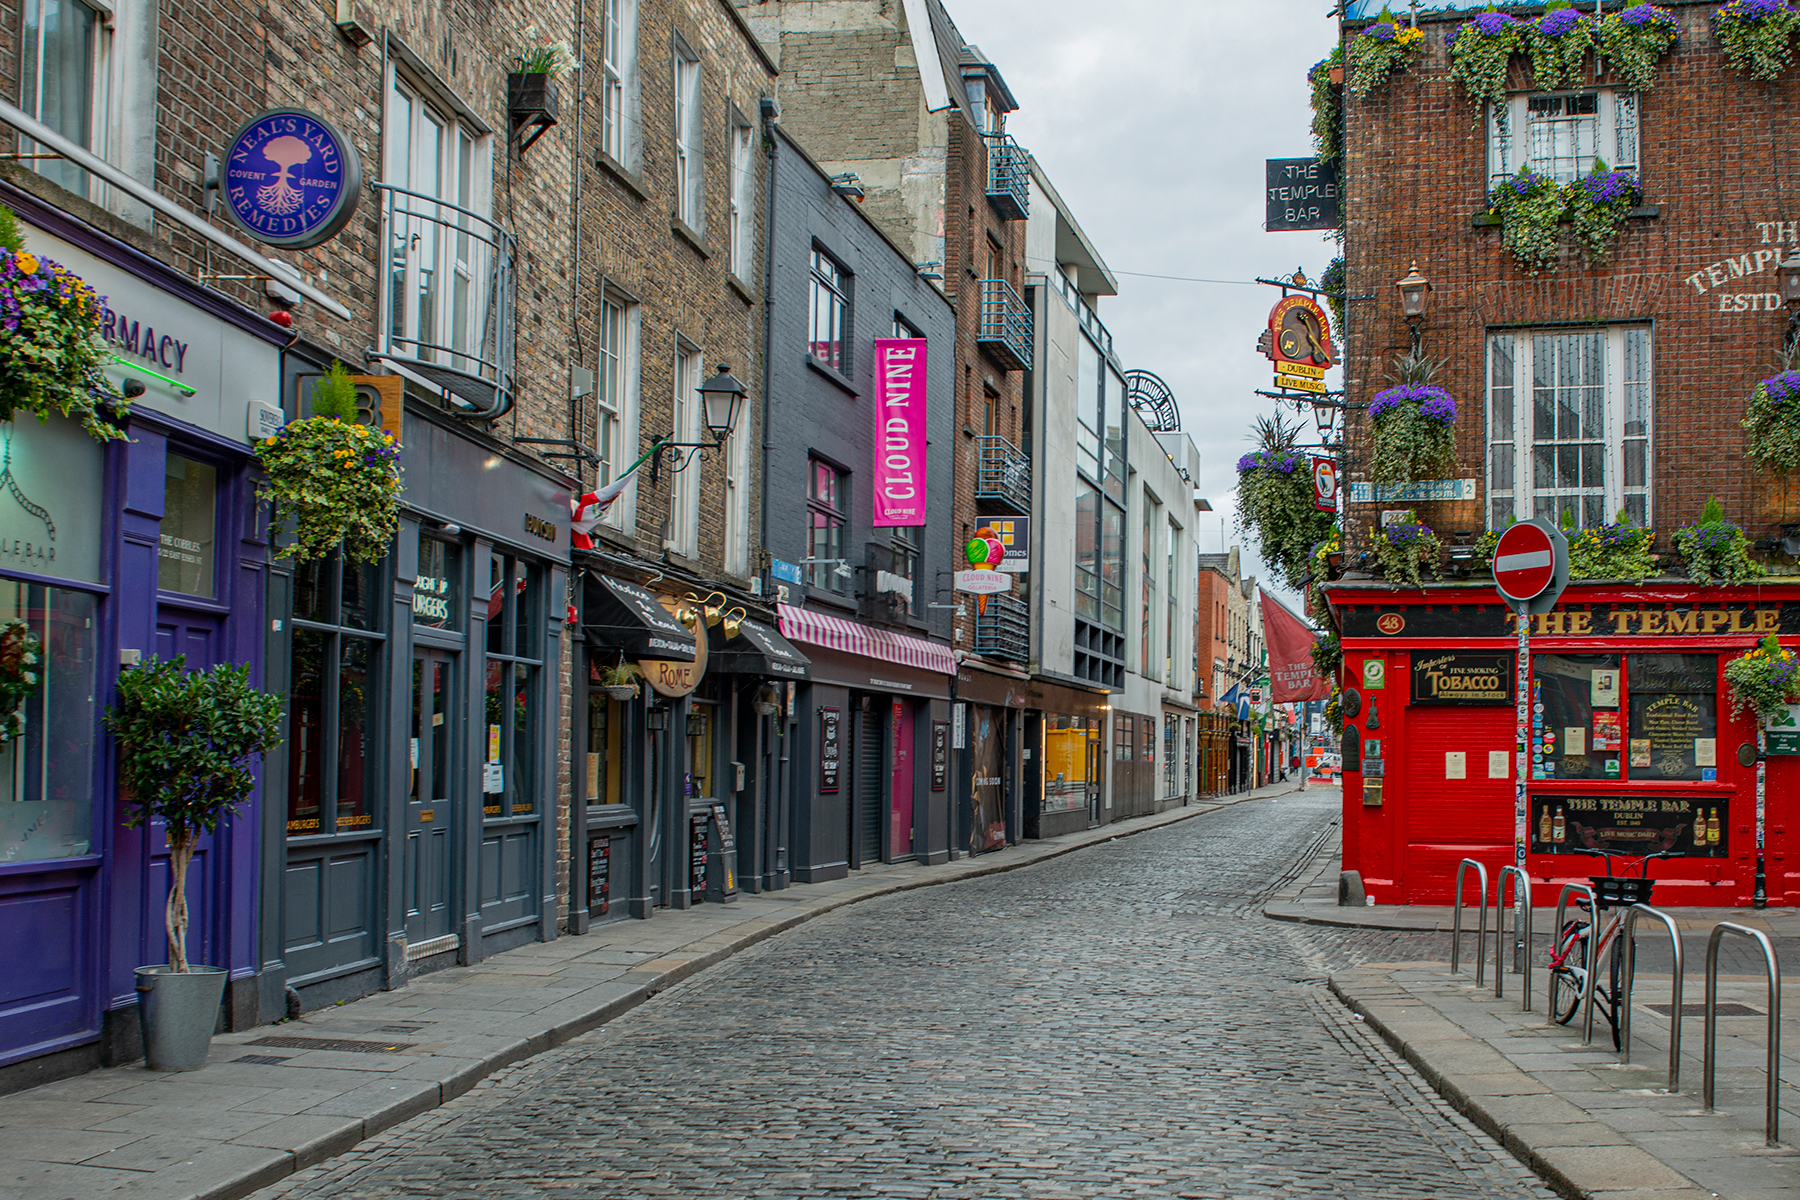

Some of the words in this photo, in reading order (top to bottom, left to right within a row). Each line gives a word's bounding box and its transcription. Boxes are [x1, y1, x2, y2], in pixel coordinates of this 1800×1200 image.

[232, 119, 297, 164] NEAL'S
[302, 122, 338, 174] YARD
[229, 169, 266, 181] COVENT
[299, 177, 337, 190] GARDEN
[1285, 165, 1318, 179] THE
[1268, 183, 1335, 201] TEMPLE
[230, 186, 330, 232] REMEDIES
[1285, 206, 1320, 222] BAR
[1683, 247, 1783, 295] TEMPL
[1274, 308, 1286, 332] THE
[1283, 298, 1320, 316] TEMPLE
[1318, 315, 1329, 341] BAR
[103, 307, 188, 373] RMACY
[885, 347, 916, 407] NINE
[1287, 364, 1317, 376] DUBLIN
[1281, 378, 1298, 388] LIVE
[1300, 381, 1323, 391] MUSIC
[884, 417, 916, 499] CLOUD
[1429, 490, 1456, 498] SOUTH
[1465, 484, 1473, 494] 2
[884, 508, 902, 516] CLOUD
[903, 508, 916, 516] NINE
[160, 533, 174, 547] THE
[173, 537, 202, 553] COBBLES
[1003, 548, 1027, 557] omes
[413, 575, 437, 590] IGHT
[962, 573, 985, 583] CLOUD
[986, 574, 1004, 584] NINE
[412, 593, 449, 620] URGERS
[1380, 615, 1399, 630] 48
[1506, 611, 1594, 636] THE
[1609, 609, 1783, 635] TEMPLE
[1287, 662, 1307, 671] THE
[1414, 654, 1457, 672] Importers
[658, 662, 693, 689] ROME
[1274, 670, 1320, 681] TEMPL
[1287, 679, 1311, 690] BAR
[1424, 671, 1500, 696] TOBACCO
[1645, 698, 1680, 712] TEMPLE
[1682, 700, 1699, 713] BAR
[975, 777, 988, 786] COMING
[989, 777, 1001, 786] SOON
[1566, 798, 1598, 812] THE
[1600, 799, 1658, 812] TEMPLE
[1660, 800, 1691, 813] BAR
[286, 818, 320, 830] AMBURGERS
[335, 815, 372, 826] EESEBURGERS
